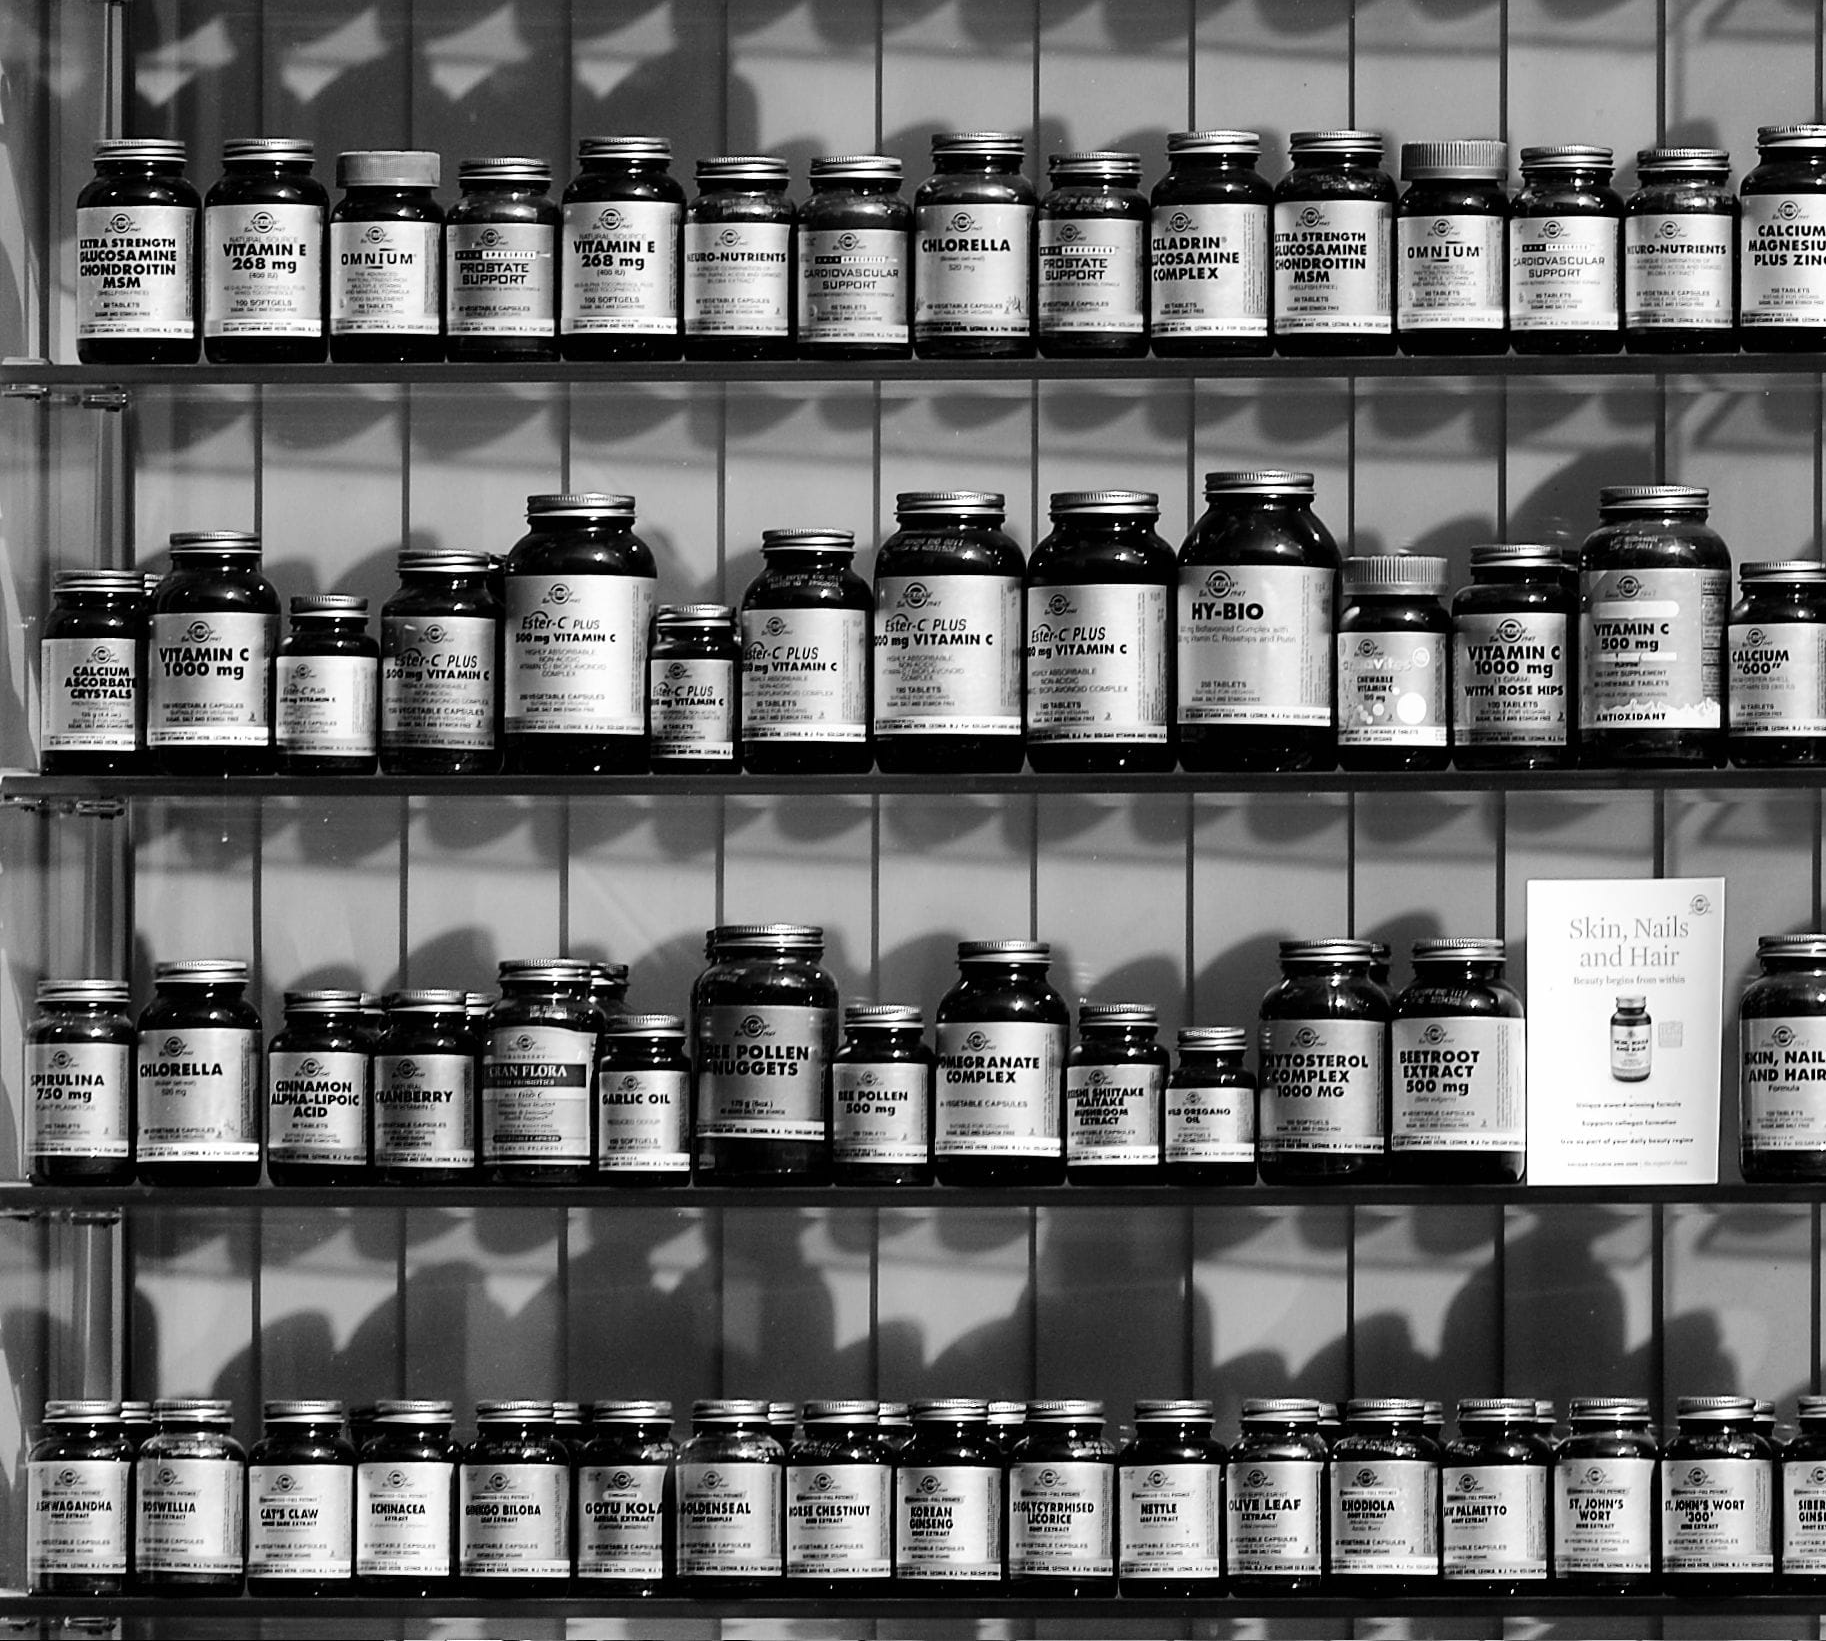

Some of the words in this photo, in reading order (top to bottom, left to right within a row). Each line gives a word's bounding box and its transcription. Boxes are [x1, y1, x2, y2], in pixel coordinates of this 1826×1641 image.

[1758, 225, 1825, 237] CALCIUM
[922, 239, 1010, 252] CHLORELLA
[80, 250, 176, 262] GLUCOSAMINE
[1754, 254, 1787, 266] PLUS
[80, 264, 175, 276] CHONDROITIN
[103, 277, 140, 288] MSM
[1192, 603, 1263, 620] HY-BIO
[1468, 646, 1544, 662] VITAMIN
[1551, 644, 1562, 661] C
[1475, 659, 1519, 675] 1000
[1527, 664, 1553, 678] mg
[1465, 683, 1496, 699] WITH
[1499, 685, 1532, 695] ROSE
[1538, 685, 1563, 696] HIPS
[1596, 713, 1665, 721] ANTIOXIDANT
[1570, 917, 1627, 942] Skin,
[1635, 915, 1688, 938] Nails
[1580, 944, 1622, 967] and
[1631, 945, 1679, 966] Hair
[1574, 977, 1603, 987] Beauty
[1606, 975, 1634, 986] begins
[1636, 975, 1656, 984] from
[1659, 974, 1685, 983] within
[738, 1045, 809, 1060] POLLEN
[1400, 1050, 1480, 1064] BEETROOT
[712, 1061, 798, 1076] NUGGETS
[1404, 1065, 1474, 1078] EXTRACT
[276, 1080, 352, 1094] CINNAMON
[1406, 1078, 1436, 1093] 500
[1443, 1083, 1468, 1096] mg
[271, 1092, 359, 1106] ALPHA-LIPOIC
[293, 1106, 327, 1118] ACID
[289, 1509, 318, 1519] CLAW
[910, 1505, 952, 1519] KOREAN
[1141, 1503, 1177, 1514] NETTLE
[1579, 1509, 1610, 1521] WORT
[910, 1517, 953, 1529] GINSENG
